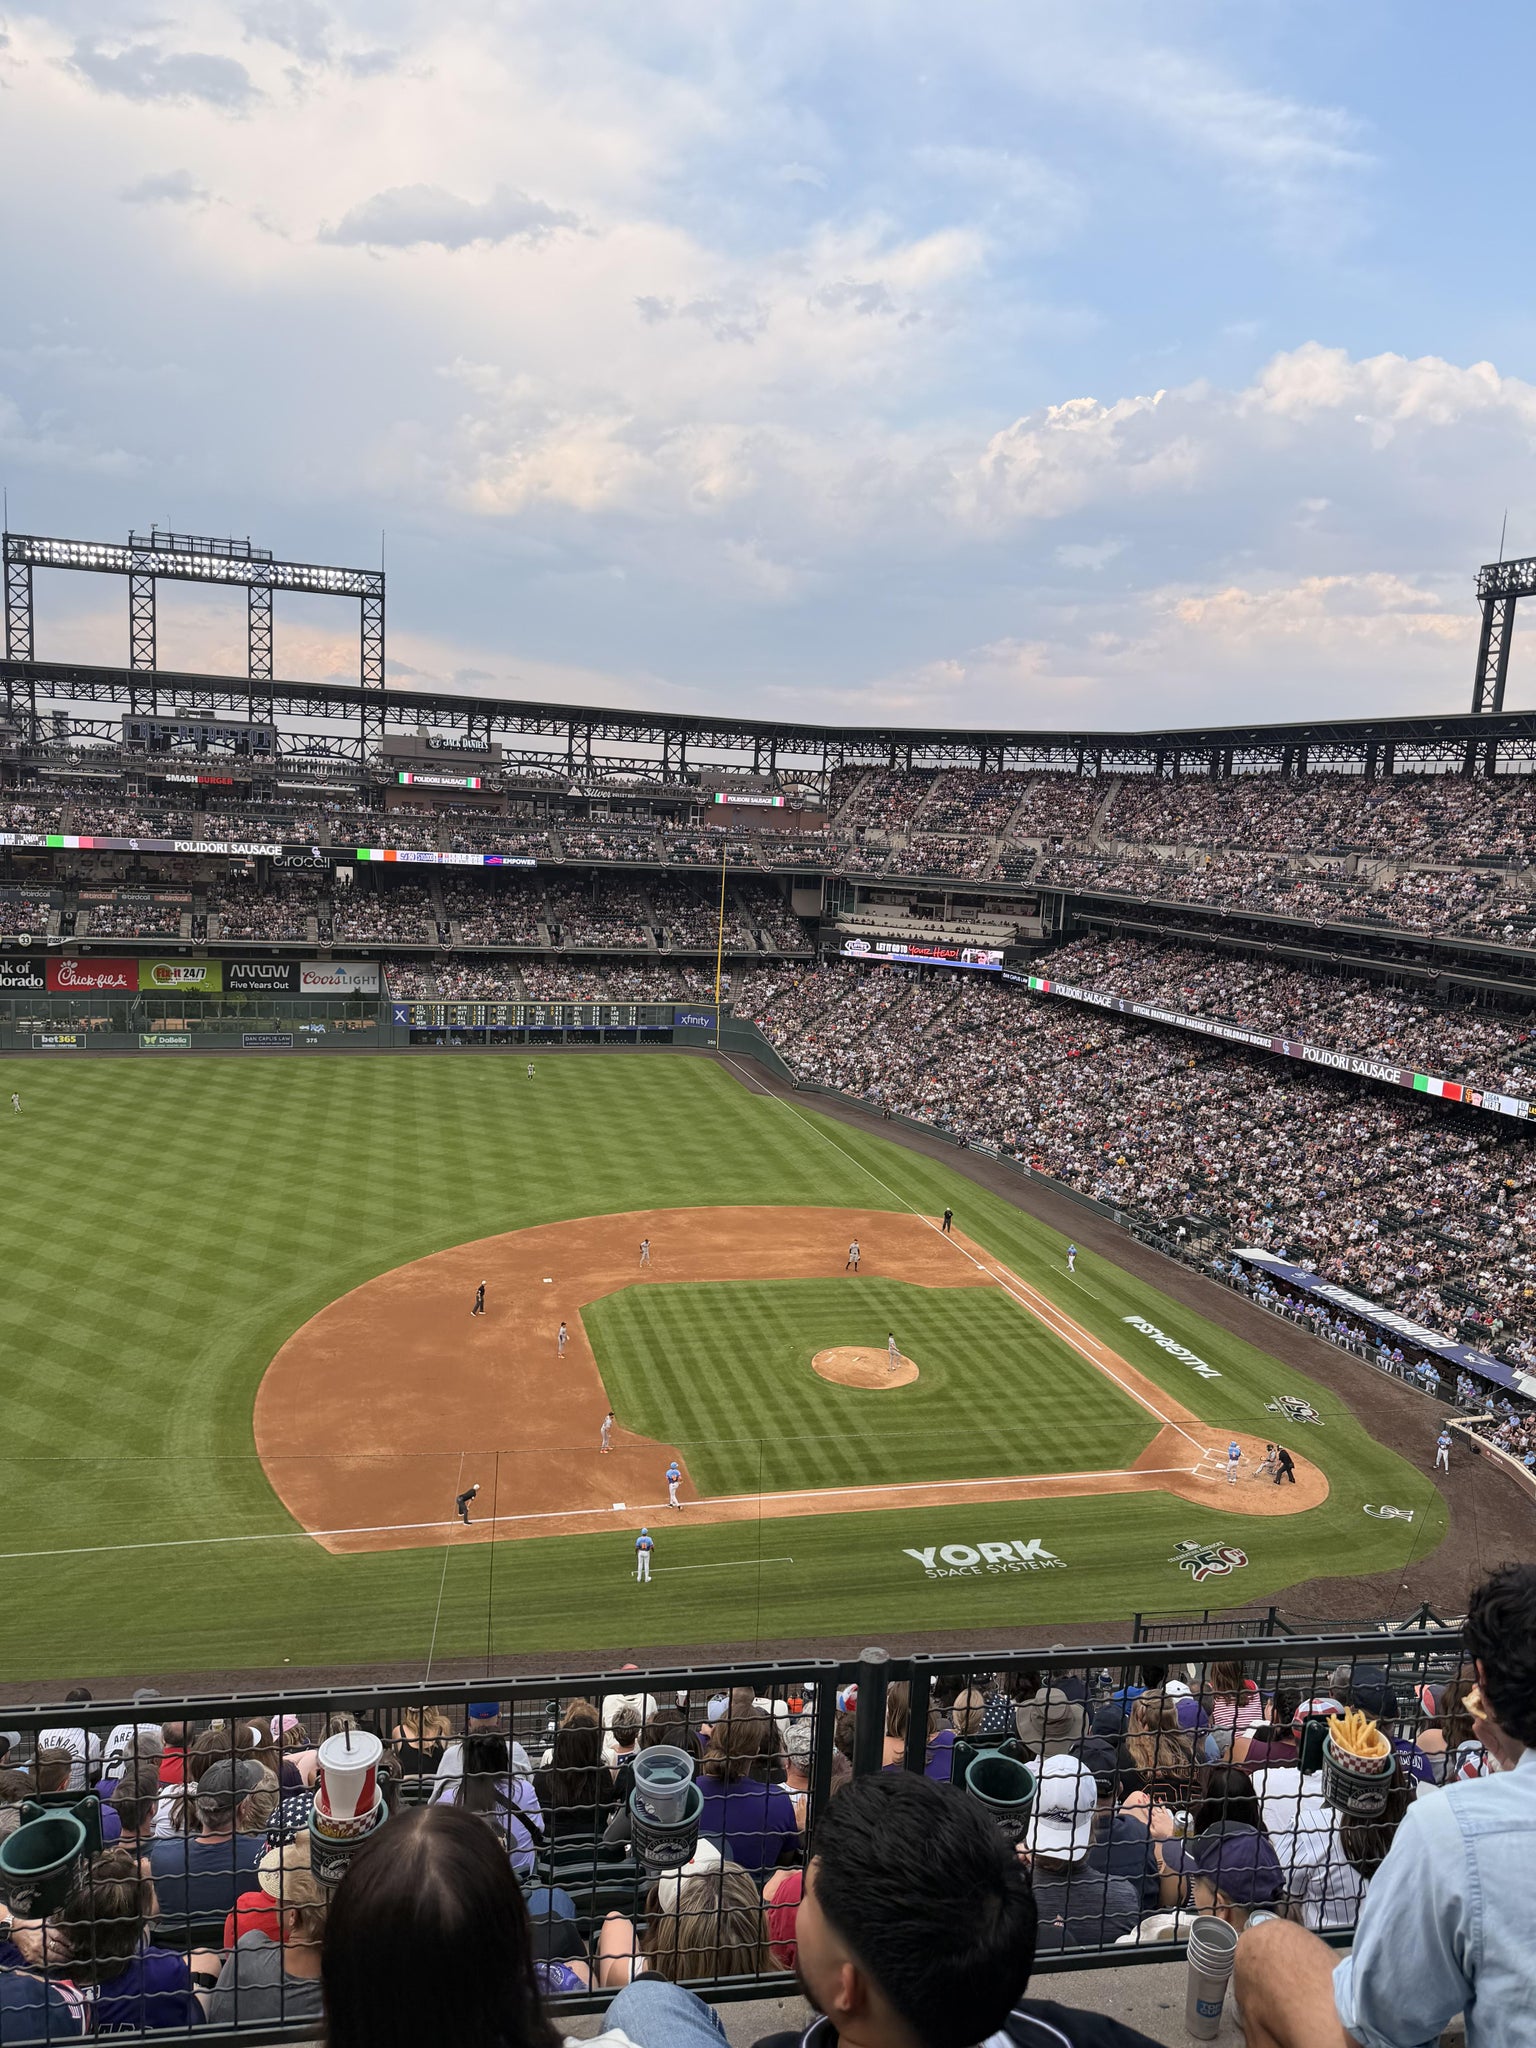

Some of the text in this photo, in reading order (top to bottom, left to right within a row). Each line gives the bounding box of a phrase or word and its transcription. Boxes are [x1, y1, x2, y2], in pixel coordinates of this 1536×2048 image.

[178, 725, 273, 746] ROOFTOP
[443, 738, 461, 748] JACK
[165, 773, 234, 785] SMASHBURGER
[413, 775, 467, 786] POLIDORI SAUSAGE
[583, 787, 611, 799] Silver
[174, 841, 283, 856] POLIDORI SAUSAGE
[502, 856, 536, 866] EMPOWER
[20, 936, 30, 944] 33
[876, 942, 887, 952] LET
[933, 947, 960, 959] HEAD!
[16, 960, 31, 974] of
[156, 967, 206, 979] Fix-it 24/7
[230, 964, 290, 978] ARROW
[0, 973, 44, 987] lorado
[230, 981, 290, 989] Five Years Out
[302, 971, 377, 985] Coors LIGHT
[1055, 984, 1112, 1008] POLIDORI SAUSAGE
[681, 1014, 710, 1027] xfinity
[1132, 1004, 1272, 1048] OFFICIAL BRATWURST AND SAUSAGE OF THE COLORADO ROCKIES
[41, 1034, 77, 1043] bet365
[158, 1036, 187, 1044] DaBella
[1302, 1046, 1402, 1084] POLIDORI SAUSAGE
[1310, 1284, 1460, 1349] COLORADO ROCKIES
[1133, 1322, 1223, 1379] TALLGRASS
[901, 1538, 1059, 1569] YORK
[924, 1559, 1068, 1579] SPACE SYSTEMS
